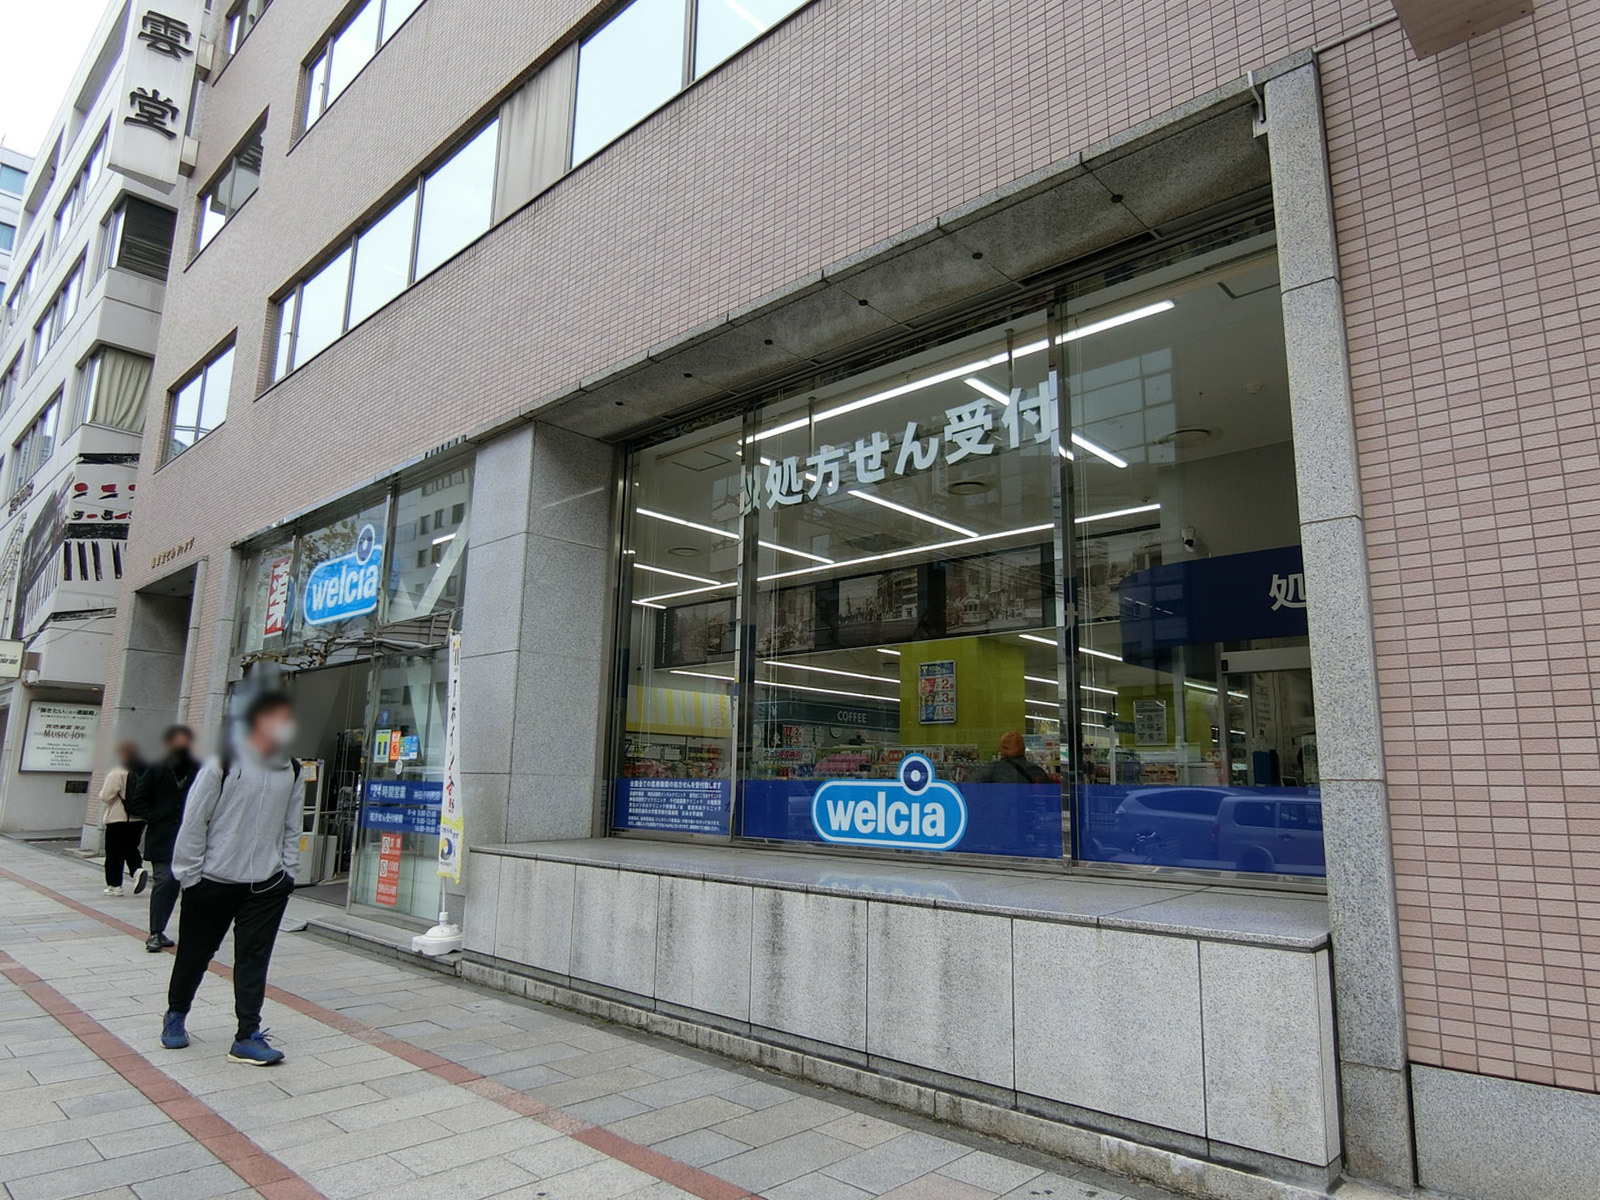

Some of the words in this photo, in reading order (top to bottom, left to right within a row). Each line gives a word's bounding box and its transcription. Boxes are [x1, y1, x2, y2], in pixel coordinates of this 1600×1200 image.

[123, 10, 194, 140] 雲堂
[765, 381, 1055, 510] 処方せん受付
[312, 564, 379, 613] welcia
[837, 710, 868, 724] COFFEE
[826, 791, 946, 838] welcia
